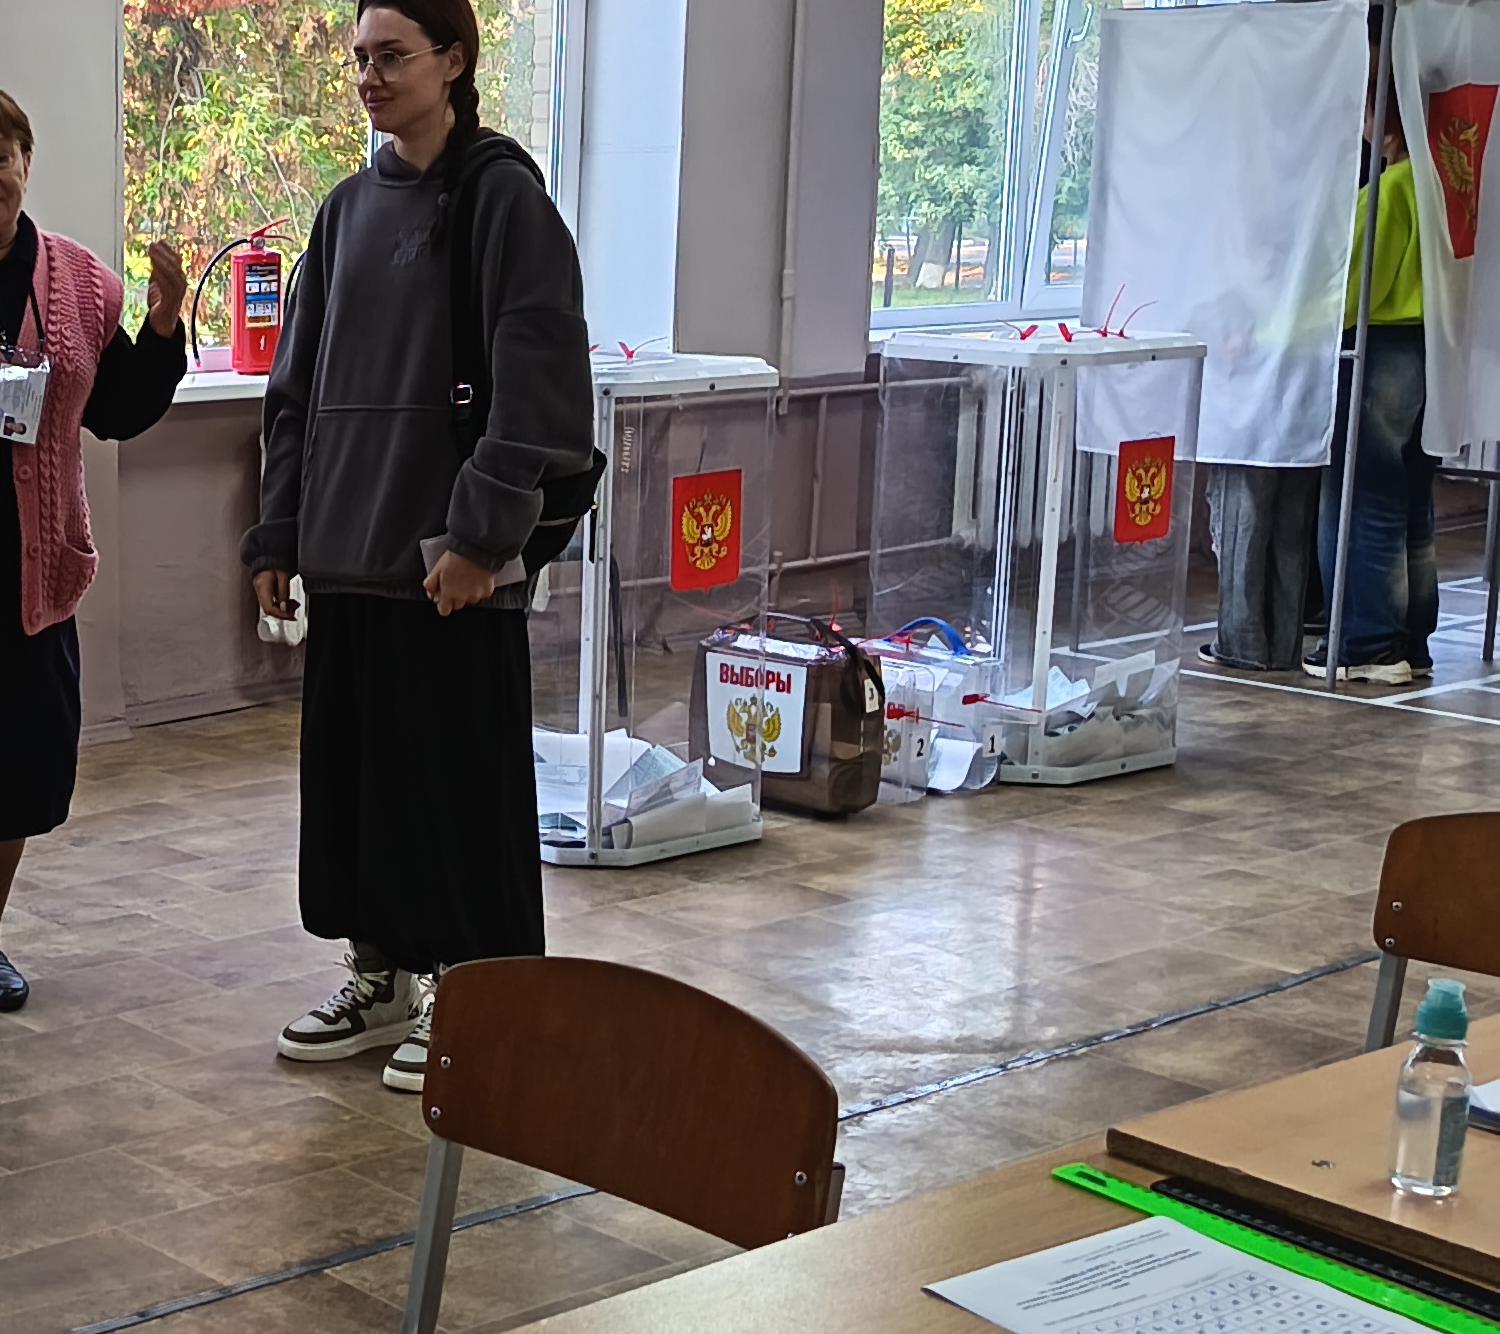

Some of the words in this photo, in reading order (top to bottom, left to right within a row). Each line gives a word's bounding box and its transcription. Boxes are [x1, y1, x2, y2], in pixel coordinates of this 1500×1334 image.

[719, 662, 792, 694] ВЫБОРЫ
[868, 687, 875, 701] 3
[916, 737, 924, 757] 2
[989, 735, 996, 753] 1
